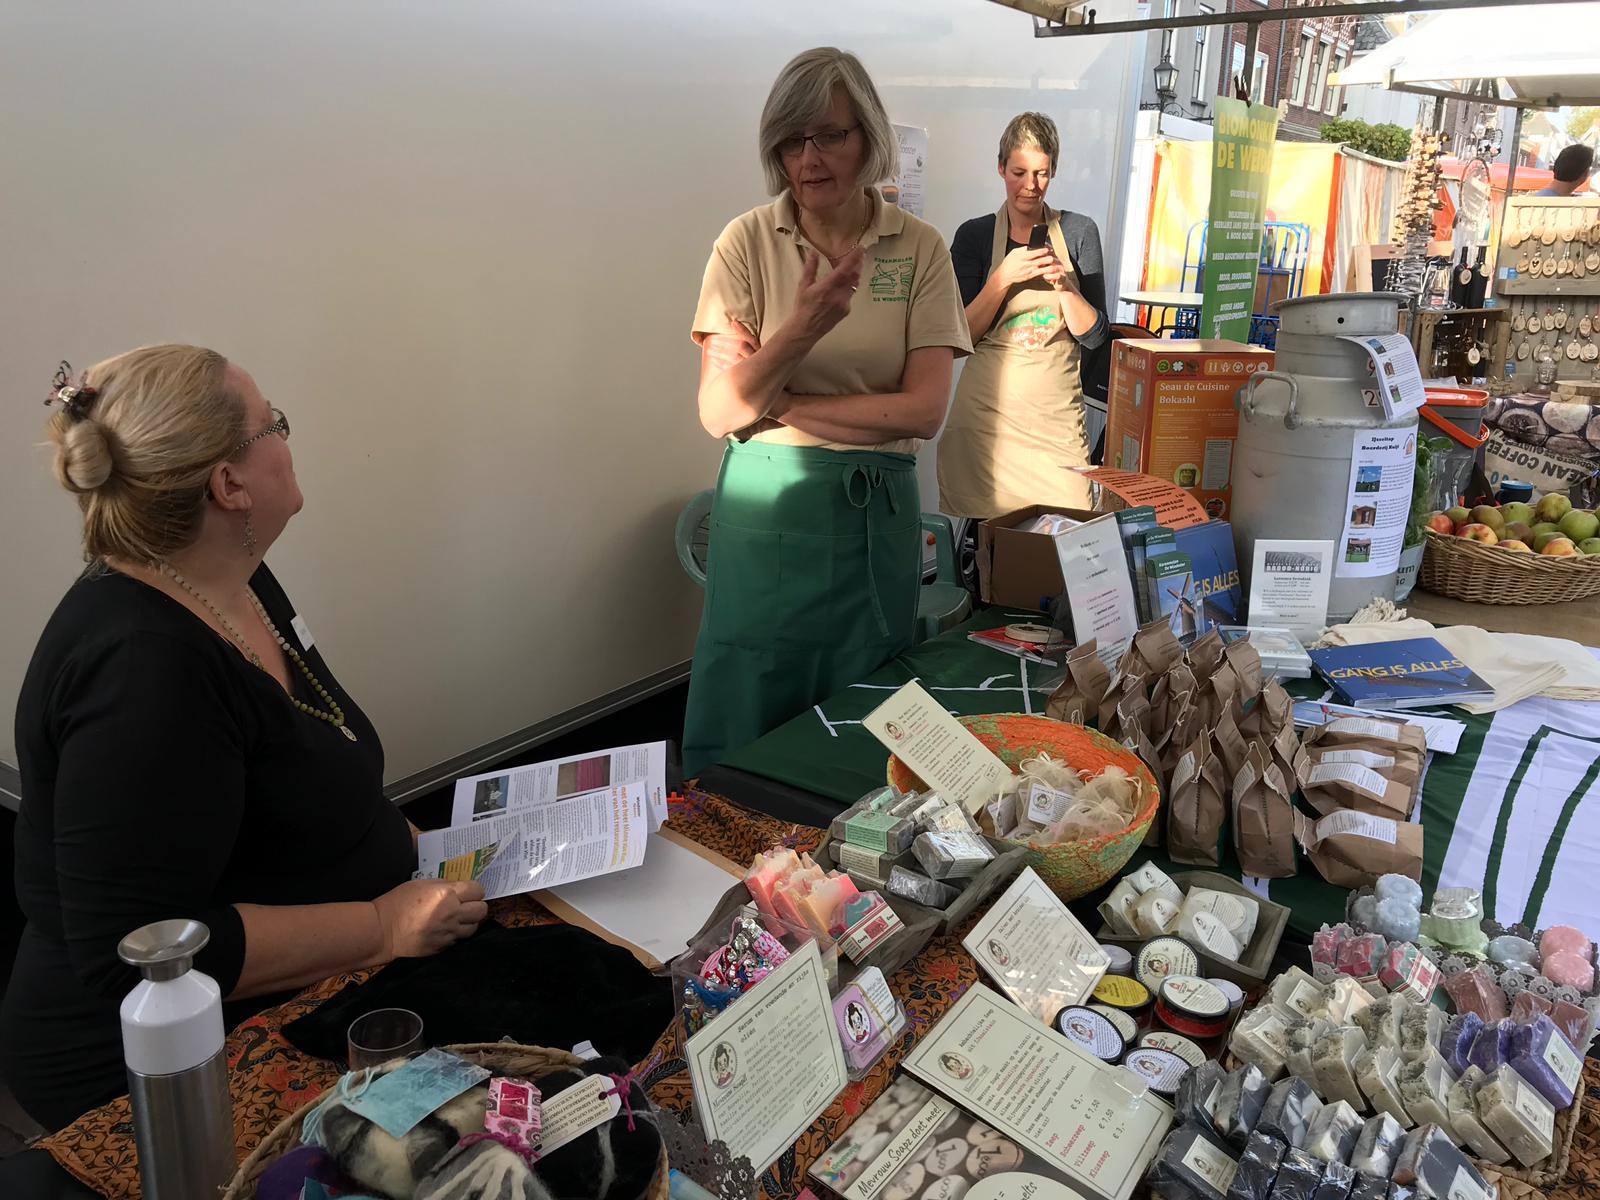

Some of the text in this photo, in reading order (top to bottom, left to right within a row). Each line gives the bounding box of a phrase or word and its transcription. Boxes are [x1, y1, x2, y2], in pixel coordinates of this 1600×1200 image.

[1217, 141, 1235, 169] DE
[1369, 354, 1377, 376] 9
[1160, 383, 1230, 392] Seau de Cuisine
[1160, 396, 1195, 404] Bokashi
[1487, 440, 1539, 470] COFFEE
[1203, 571, 1240, 596] IS ALLES
[1330, 660, 1464, 679] GANG IS ALLES
[855, 1100, 943, 1196] Mevrouw Soapz doet mee!
[1044, 1131, 1060, 1148] Zeep
[1058, 1122, 1088, 1158] Scheerzeep
[1073, 1138, 1098, 1168] Viltzeep
